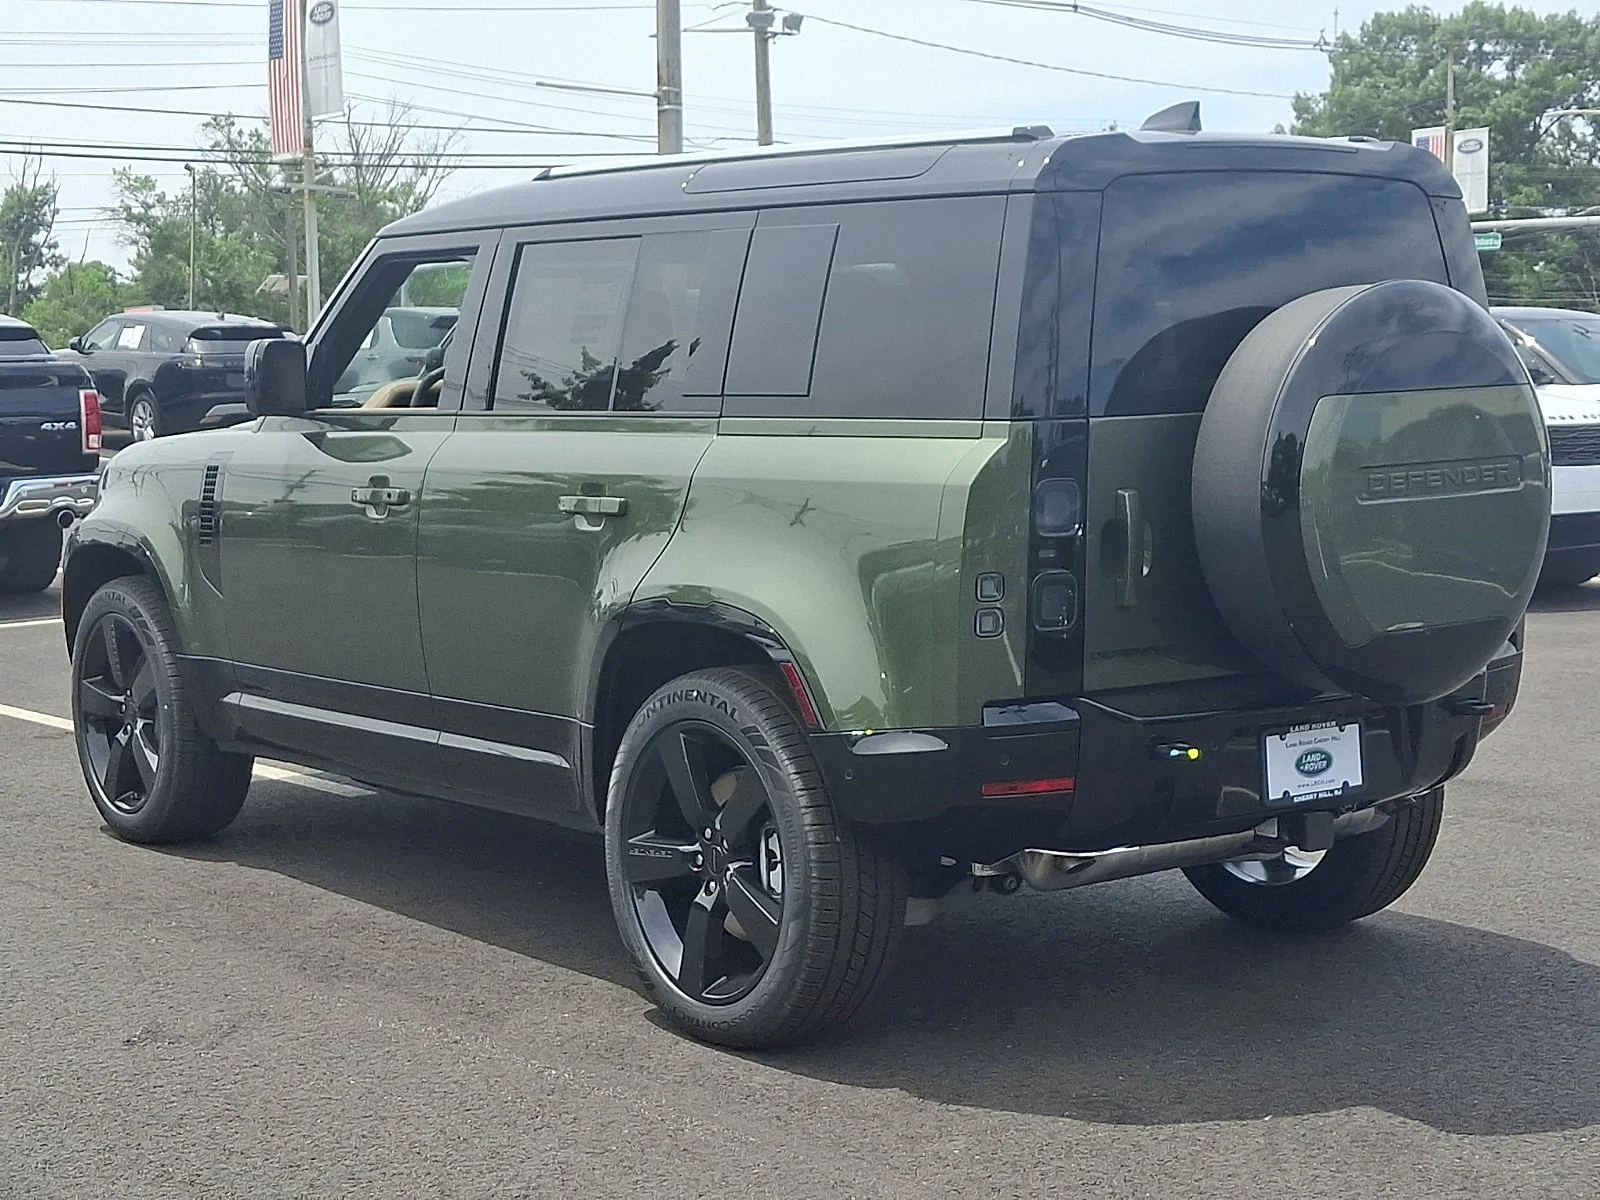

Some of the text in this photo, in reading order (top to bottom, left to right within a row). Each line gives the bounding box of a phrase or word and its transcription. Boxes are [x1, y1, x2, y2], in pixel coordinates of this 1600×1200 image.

[1368, 463, 1509, 492] DEFENDER
[1290, 721, 1337, 733] LAND ROVER
[1301, 752, 1321, 763] LAND
[1304, 760, 1328, 771] ROVER
